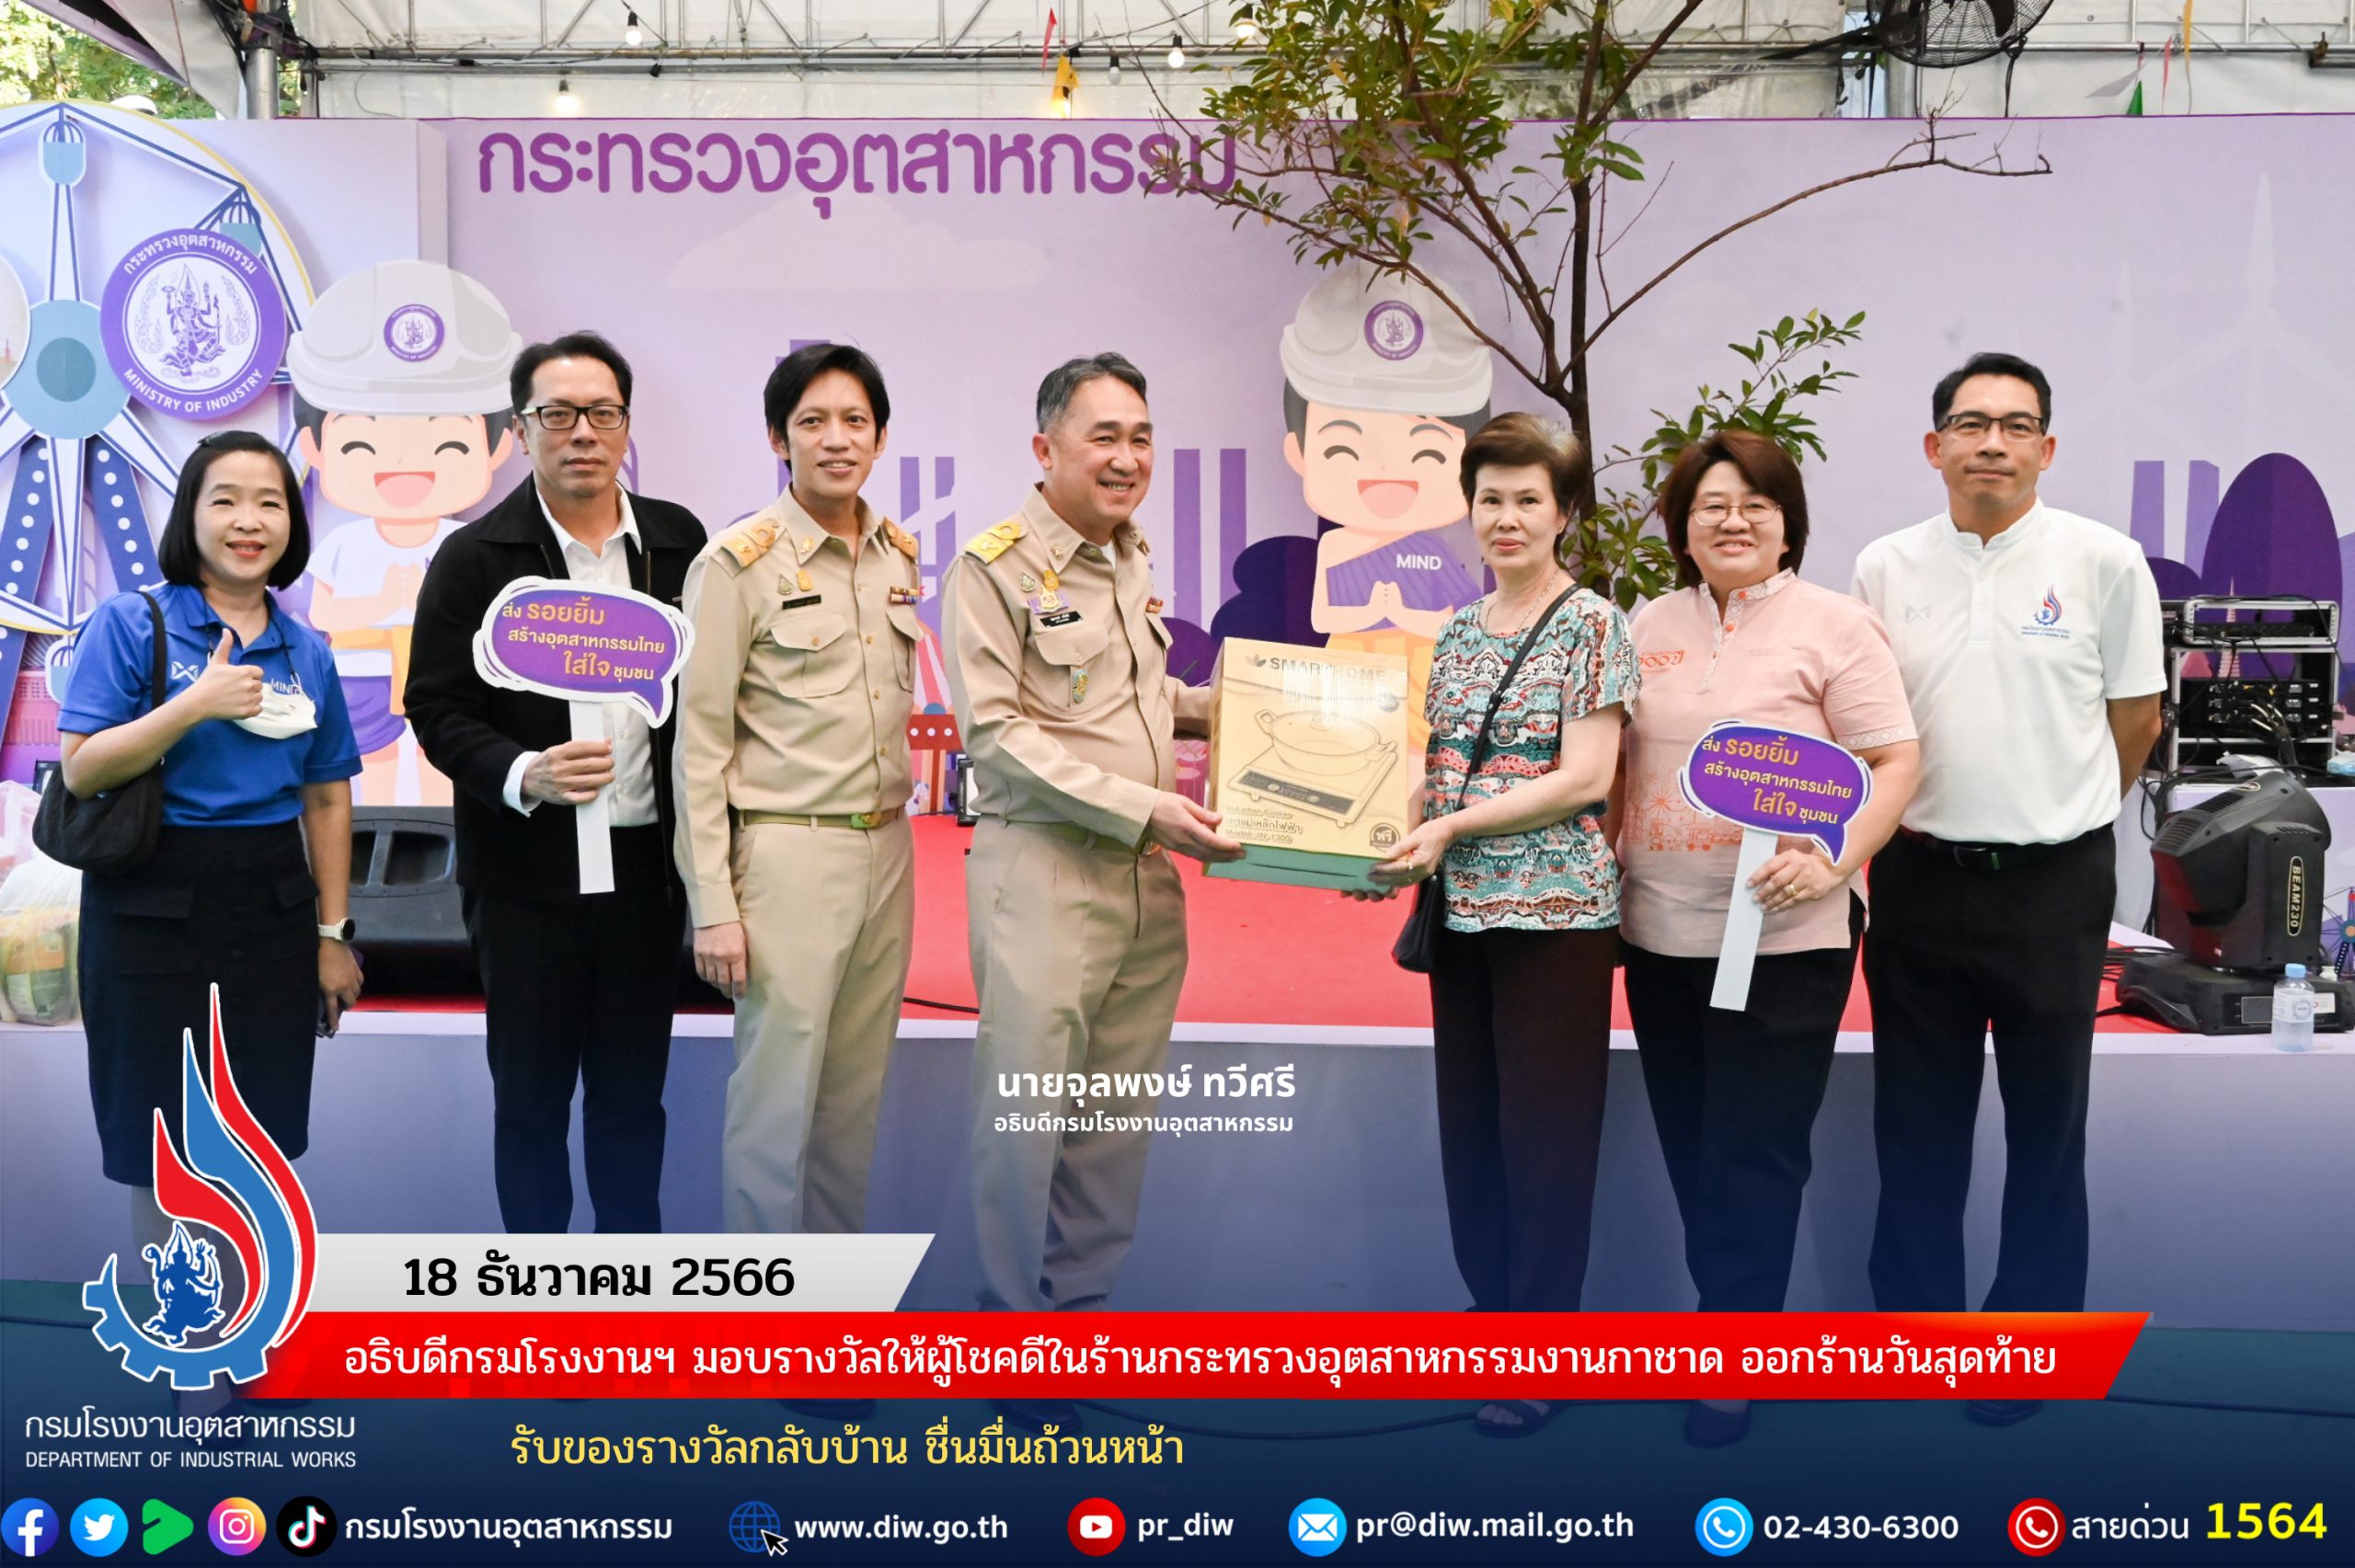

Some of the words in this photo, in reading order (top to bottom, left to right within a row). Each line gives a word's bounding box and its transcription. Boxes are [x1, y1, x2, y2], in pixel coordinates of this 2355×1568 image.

[478, 132, 1236, 220] กระทรวงอุตสาหกรรม
[123, 235, 258, 275] กระทรวงอุตสาหกรรม
[123, 368, 182, 411] MINISTRY
[184, 401, 203, 413] OF
[205, 368, 264, 412] INDUSTRY
[1396, 554, 1442, 571] MIND
[502, 602, 522, 618] ส่ง
[526, 596, 605, 625] รอยยิ้ม
[508, 626, 665, 654] สร้างอุตสาหกรรมไทย
[563, 650, 611, 677] ใส่ใจ
[614, 666, 654, 682] ชุมชน
[1702, 735, 1720, 752] ส่ง
[1725, 735, 1799, 766] รอยยิ้ม
[1704, 760, 1853, 799] สร้างอุตสาหกรรมไทย
[1752, 788, 1798, 818] ใส่ใจ
[1799, 807, 1839, 825] ชุมชน
[2290, 865, 2302, 928] BEAM230
